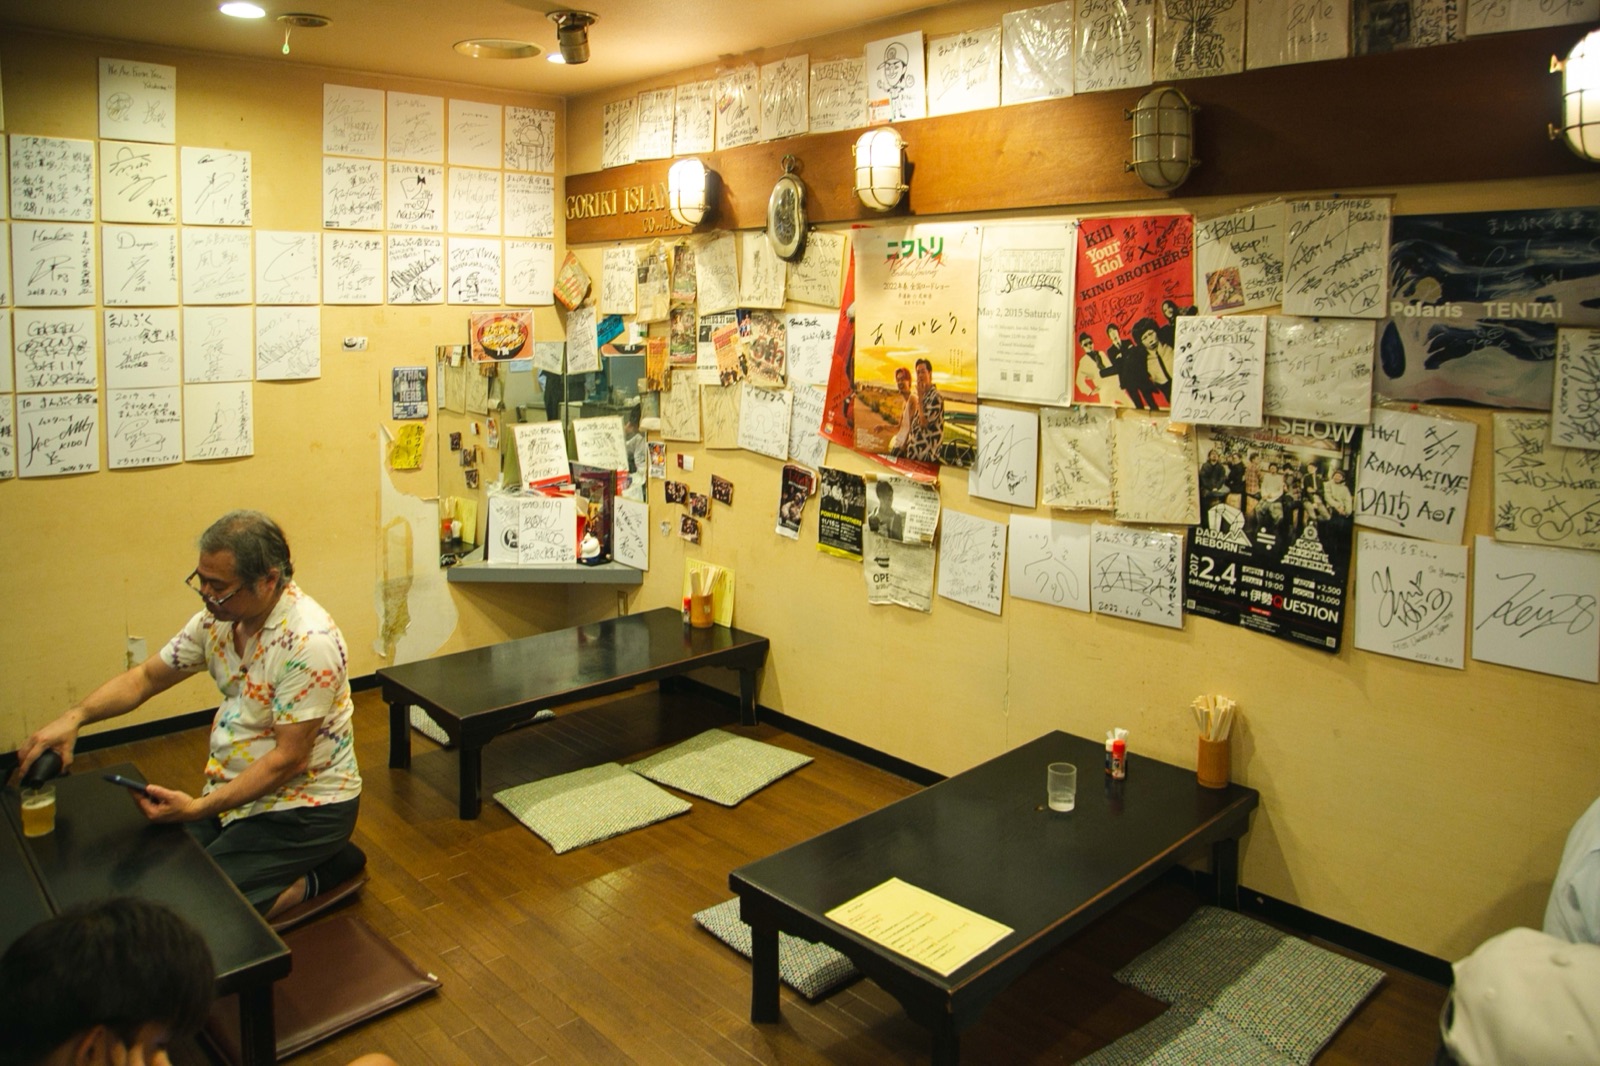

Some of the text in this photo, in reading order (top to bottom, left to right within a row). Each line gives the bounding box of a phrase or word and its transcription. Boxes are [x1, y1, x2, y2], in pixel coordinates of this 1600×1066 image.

[566, 182, 670, 220] GORIKI ISLAN
[1084, 225, 1114, 248] Kill
[887, 236, 944, 259] ニワトリ
[1086, 241, 1121, 264] Your
[1080, 246, 1190, 301] KING BROTHERS
[1093, 255, 1125, 278] Idol
[1004, 308, 1023, 318] 2015
[1024, 308, 1062, 321] Saturday
[1390, 301, 1563, 319] Polaris TENTAI
[870, 312, 968, 346] ありがとう。
[399, 391, 422, 402] HERB
[1364, 451, 1469, 490] RADIOACTIVE
[840, 515, 862, 526] BROTHERS
[1195, 527, 1224, 542] DADA
[1195, 535, 1238, 553] REBORN
[1189, 553, 1199, 577] 2017
[1199, 556, 1237, 586] 2.4
[873, 573, 889, 584] OPE
[1264, 580, 1284, 591] 19:00
[1265, 570, 1285, 581] 18:00
[1188, 577, 1236, 597] saturday night
[1240, 589, 1248, 598] at
